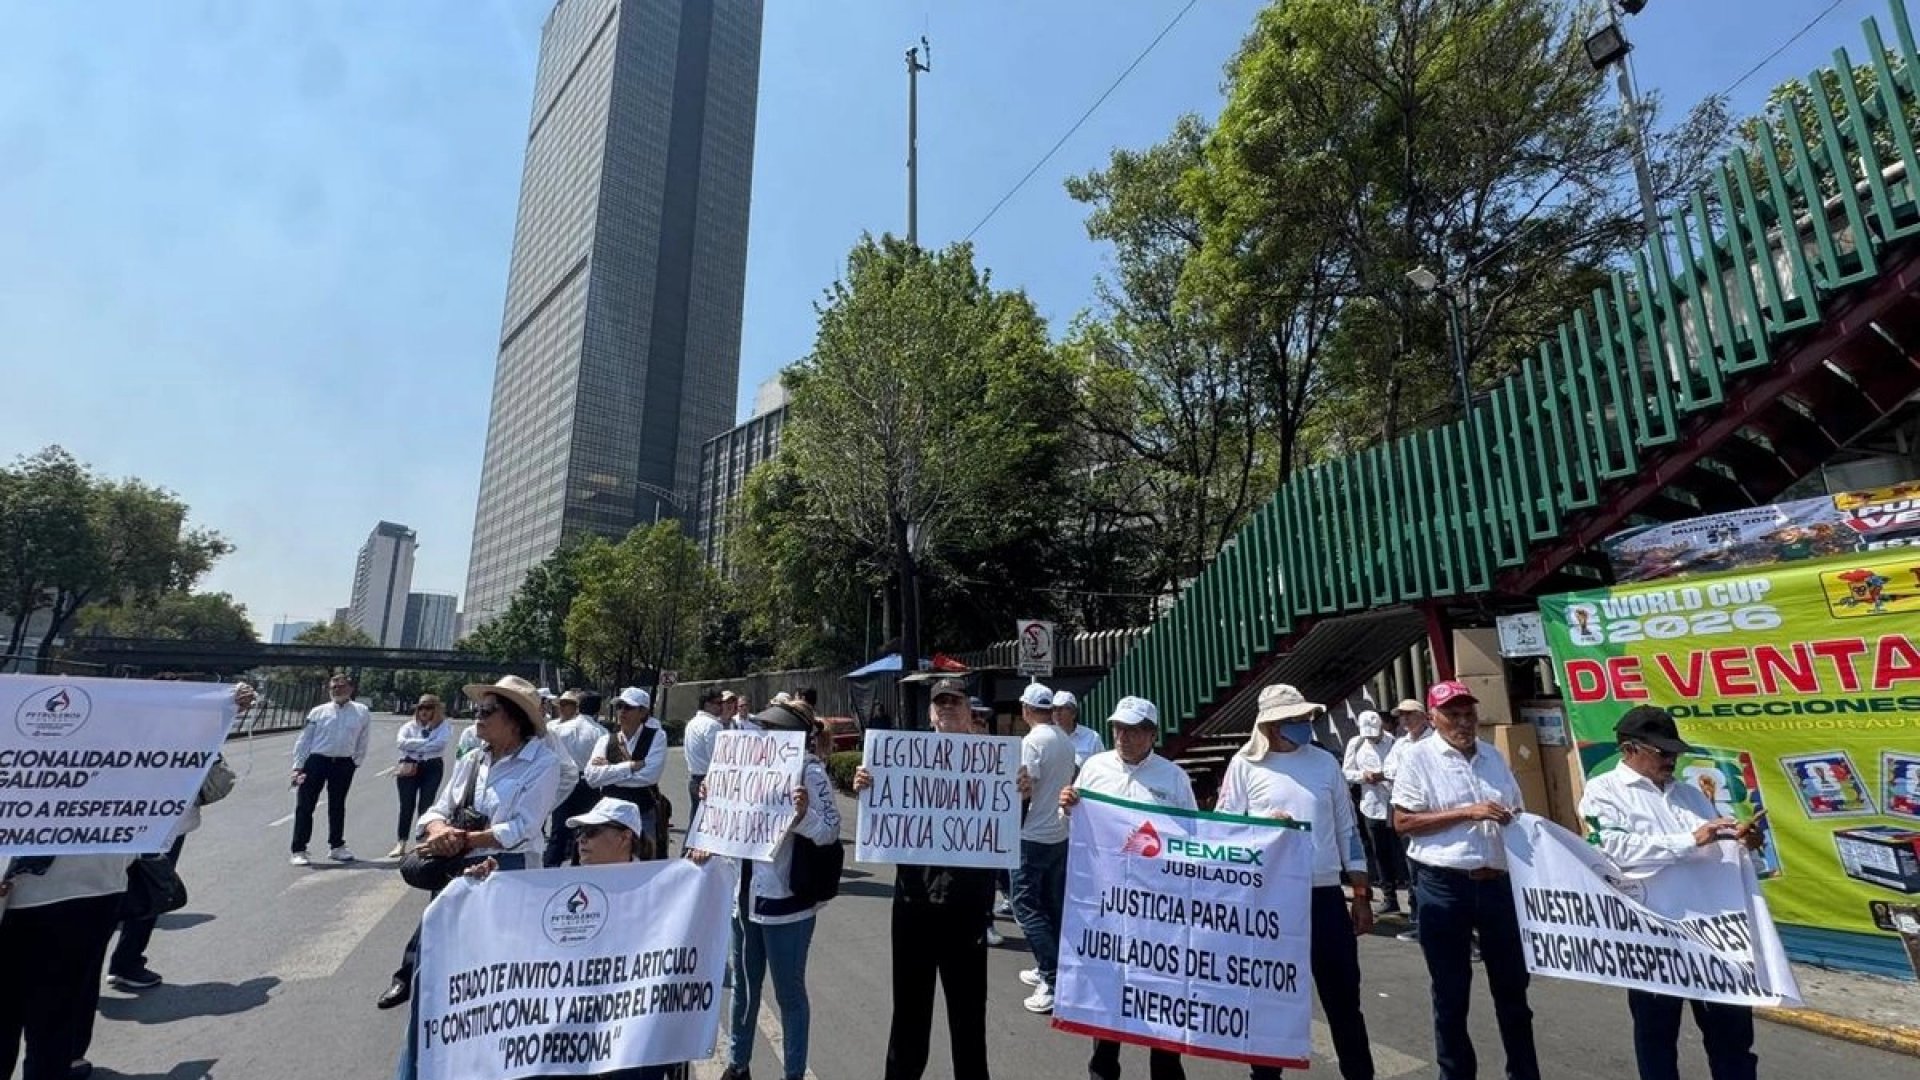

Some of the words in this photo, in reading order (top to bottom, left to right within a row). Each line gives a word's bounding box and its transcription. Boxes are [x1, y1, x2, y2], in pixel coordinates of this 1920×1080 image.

[1600, 587, 1702, 619] WORLD
[1707, 578, 1772, 607] CUP
[1606, 604, 1783, 643] 2026
[1565, 655, 1649, 703] DE
[1655, 633, 1920, 698] VENTA
[1663, 696, 1920, 718] OLECCIONES
[0, 750, 131, 768] CIONALIDAD
[135, 751, 168, 768] NO
[170, 751, 210, 768] HAY
[872, 736, 953, 771] LEGISLAR
[961, 741, 1008, 775] DESDE
[34, 801, 50, 818] A
[54, 800, 148, 817] RESPETAR
[150, 799, 187, 816] LOS
[869, 774, 894, 808] LA
[902, 775, 961, 810] ENVIDIA
[965, 778, 986, 811] NO
[992, 780, 1013, 812] ES
[743, 810, 790, 844] DERECH
[862, 813, 934, 849] JUSTICIA
[942, 816, 1011, 853] SOCIAL.
[1167, 838, 1263, 866] PEMEX
[1161, 860, 1263, 888] JUBILADOS
[1100, 886, 1186, 925] ¡JUSTICIA
[1191, 900, 1240, 935] PARA
[1245, 908, 1280, 940] LOS
[1522, 887, 1600, 928] NUESTRA
[1597, 893, 1643, 934] VIDA
[449, 967, 488, 1005] ESTADO
[490, 962, 508, 993] TE
[508, 959, 561, 990] INVITO
[562, 960, 574, 987] A
[577, 957, 611, 987] LEER
[613, 955, 628, 983] EL
[630, 947, 697, 981] ARTICULO
[1077, 928, 1179, 975] JUBILADOS
[1185, 948, 1221, 982] DEL
[1226, 955, 1297, 993] SECTOR
[1616, 940, 1690, 987] RESPETO
[1687, 951, 1706, 990] A
[1699, 952, 1737, 995] LOS
[441, 997, 550, 1045] CONSTITUCIONAL
[554, 998, 565, 1023] Y
[566, 995, 631, 1024] ATENDER
[632, 993, 648, 1017] EL
[650, 981, 713, 1013] PRINCIPIO
[1121, 986, 1250, 1039] ENERGÉTICO!
